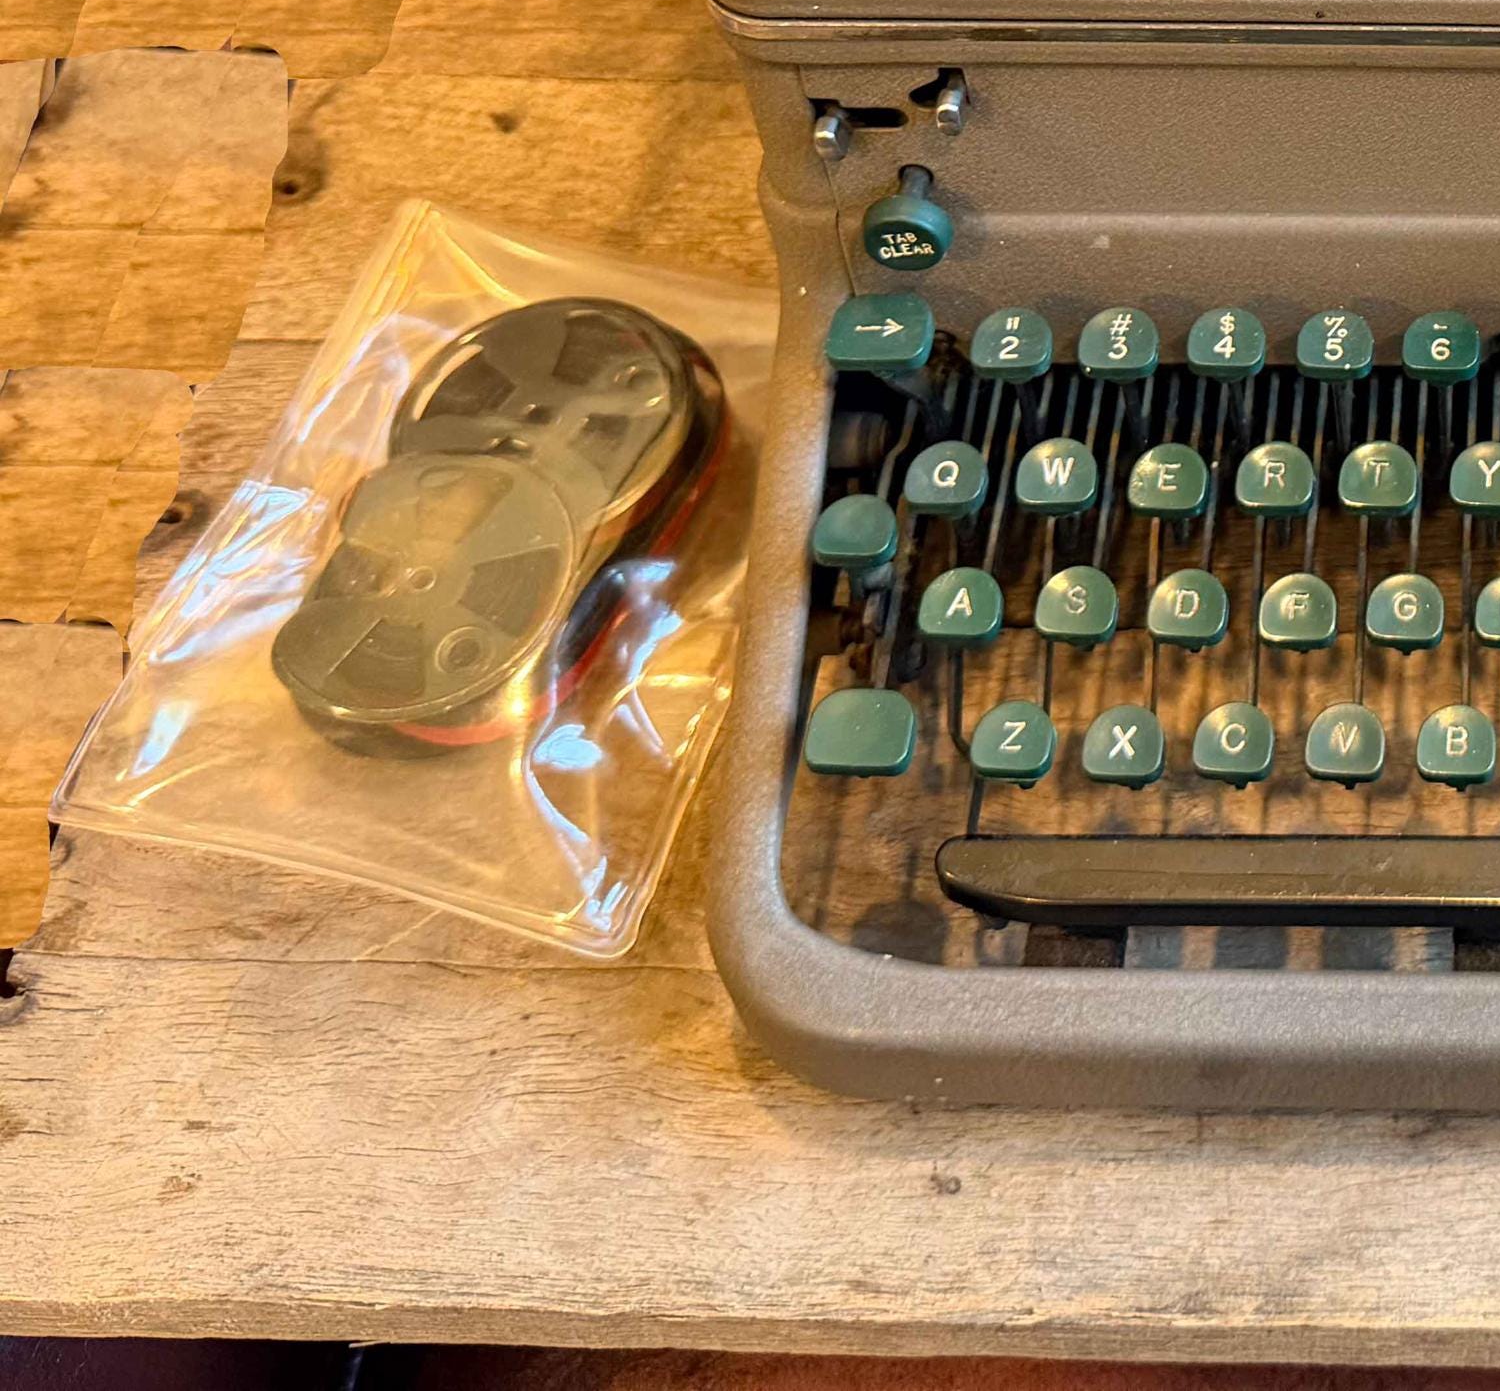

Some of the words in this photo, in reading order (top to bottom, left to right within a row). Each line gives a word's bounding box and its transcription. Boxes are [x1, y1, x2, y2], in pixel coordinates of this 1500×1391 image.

[879, 243, 934, 259] CLEAR
[881, 233, 917, 244] TAB
[1110, 314, 1132, 336] #
[1219, 312, 1235, 334] $
[1324, 316, 1348, 338] %
[999, 336, 1019, 358] 2
[1108, 336, 1128, 359] 3
[1213, 336, 1236, 358] 4
[1324, 338, 1344, 361] 5
[1431, 338, 1451, 361] 6
[932, 460, 959, 487] Q
[1040, 457, 1075, 485] W
[1158, 463, 1182, 491] E
[1264, 460, 1285, 488] R
[1364, 459, 1389, 488] T
[945, 588, 973, 617] A
[1064, 585, 1088, 615] S
[1175, 589, 1201, 618] D
[1280, 592, 1310, 621] F
[1393, 592, 1418, 622] G
[999, 721, 1027, 752] Z
[1108, 724, 1138, 760] X
[1220, 723, 1247, 754] C
[1331, 721, 1359, 754] V
[1445, 725, 1468, 756] B
